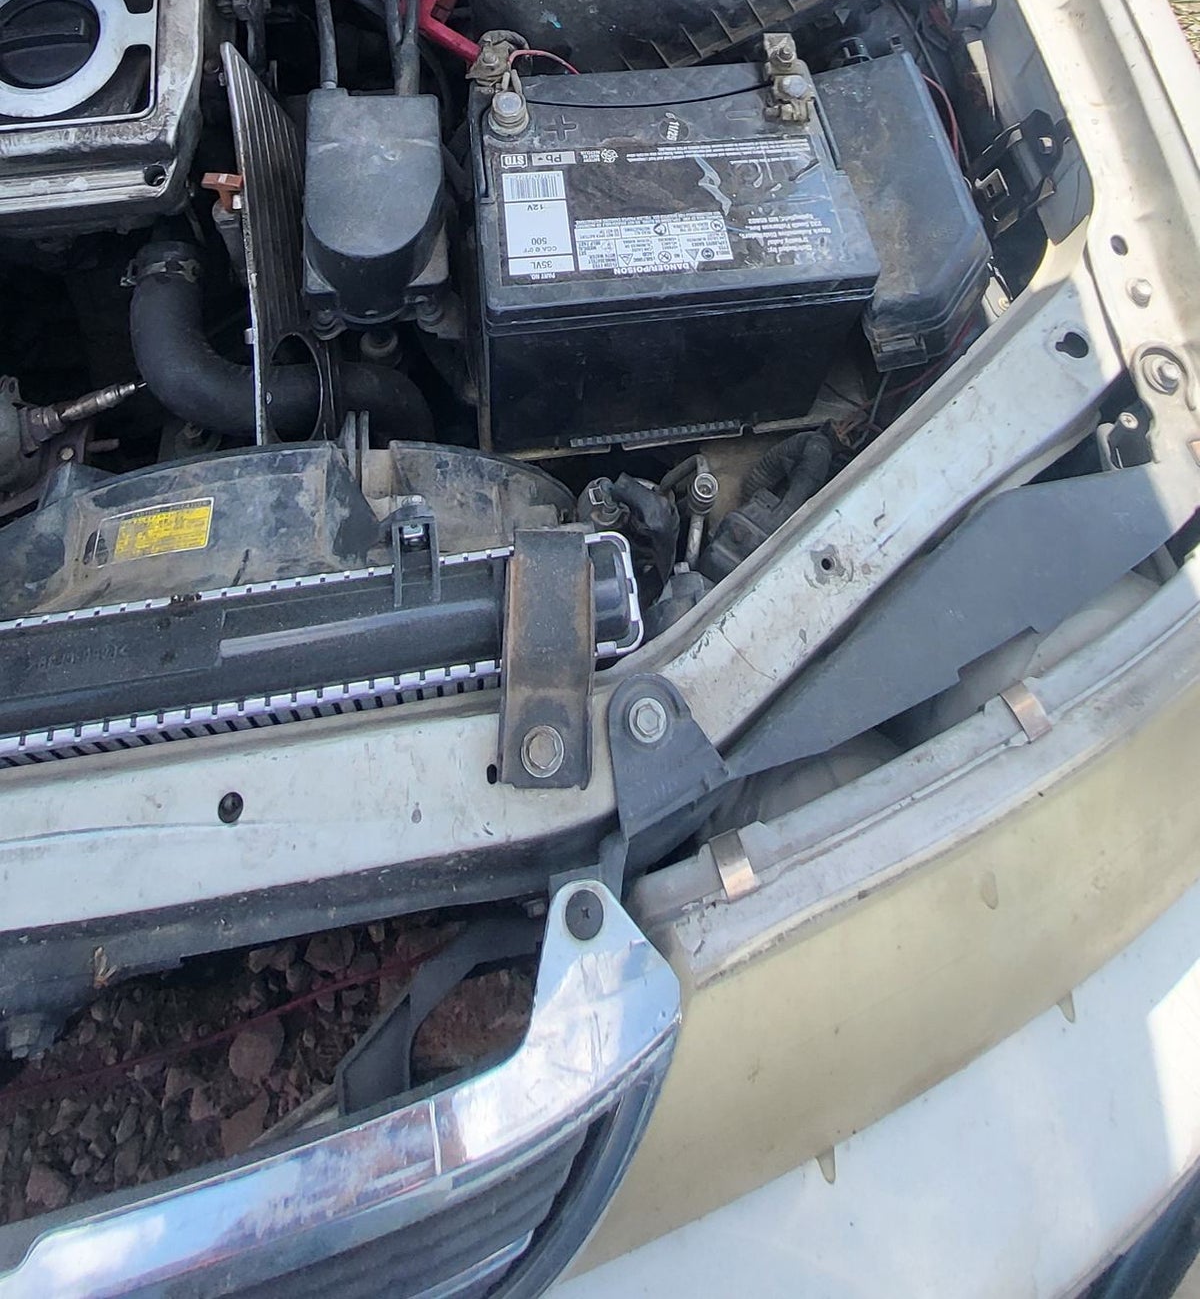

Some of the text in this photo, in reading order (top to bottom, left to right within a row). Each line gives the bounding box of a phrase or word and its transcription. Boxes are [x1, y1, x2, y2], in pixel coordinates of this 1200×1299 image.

[504, 156, 525, 166] STD
[545, 154, 562, 163] Pb
[531, 237, 548, 245] 500
[530, 260, 553, 269] 35VL
[613, 262, 690, 275] DANGER/POISON
